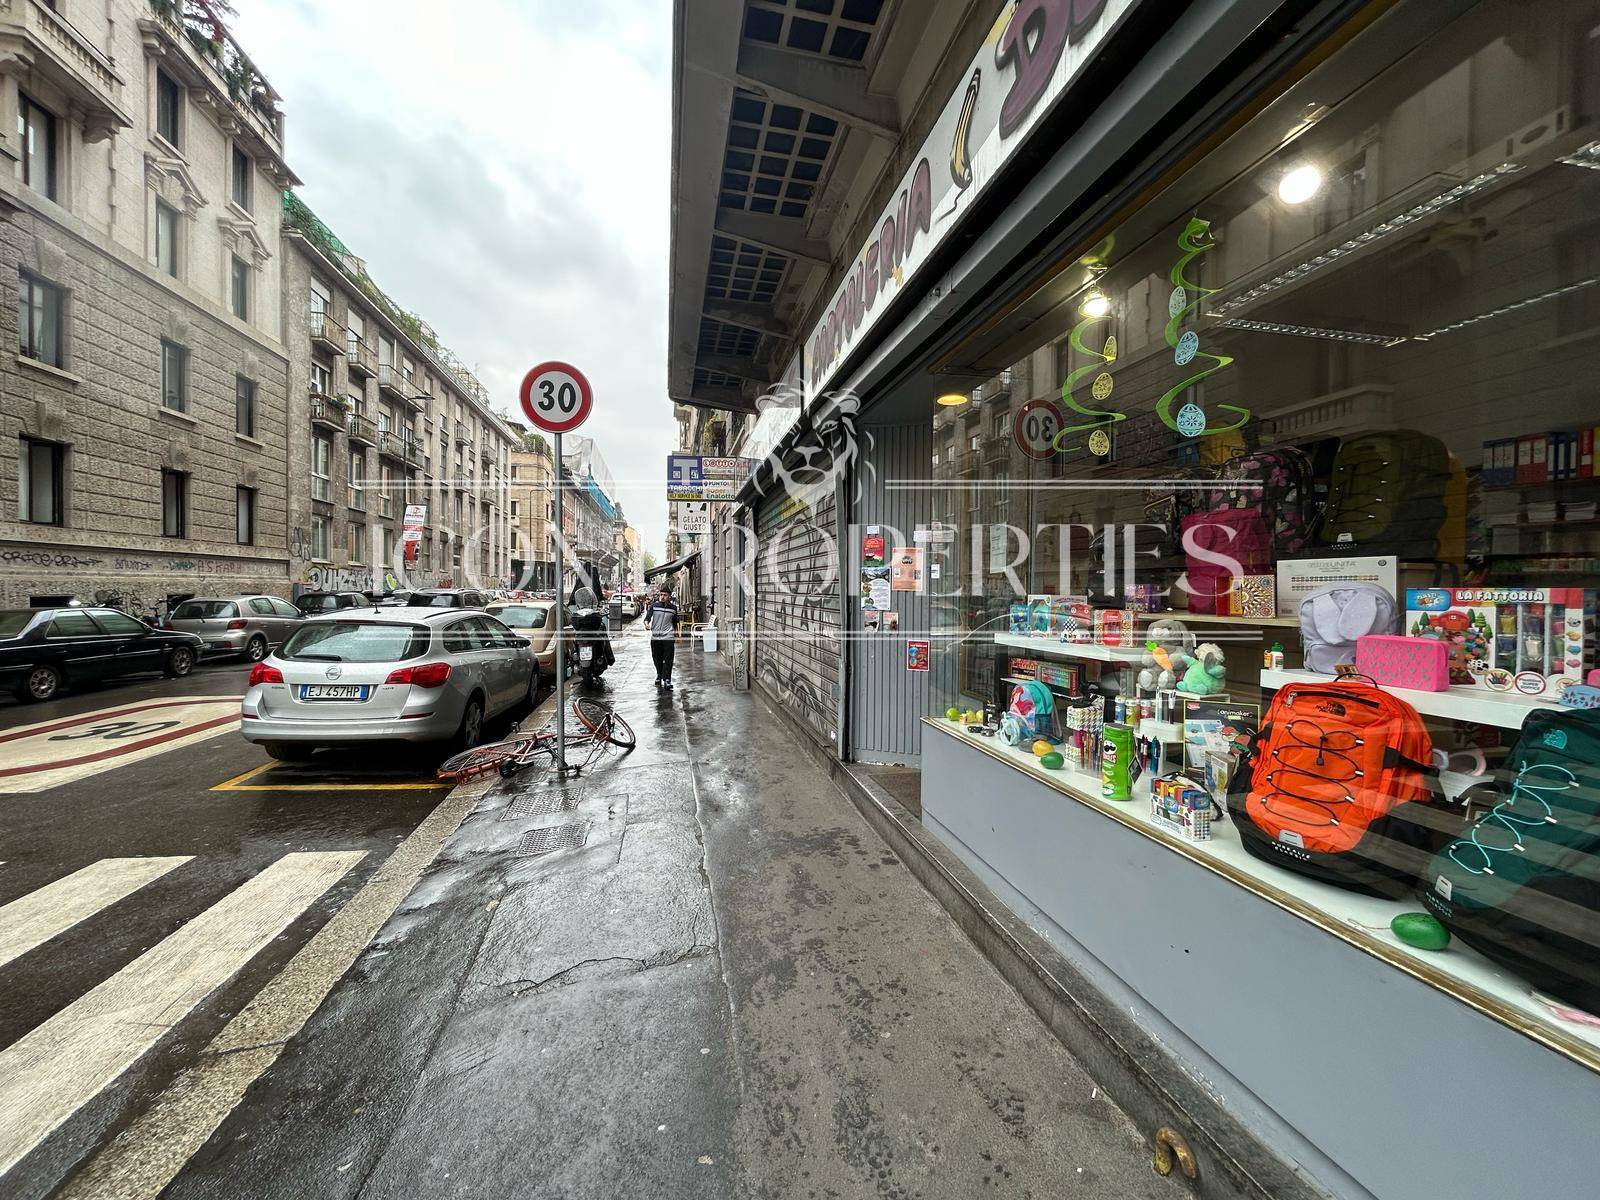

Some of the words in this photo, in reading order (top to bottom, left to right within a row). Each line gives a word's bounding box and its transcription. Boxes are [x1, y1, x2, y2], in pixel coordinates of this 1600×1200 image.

[537, 380, 576, 413] 30
[707, 492, 735, 500] Enalotto
[683, 516, 707, 524] GELATO
[1456, 591, 1473, 601] LA
[1476, 590, 1544, 602] FATTORIA
[308, 686, 322, 697] EJ
[325, 686, 361, 698] 457HP
[47, 720, 182, 741] 30
